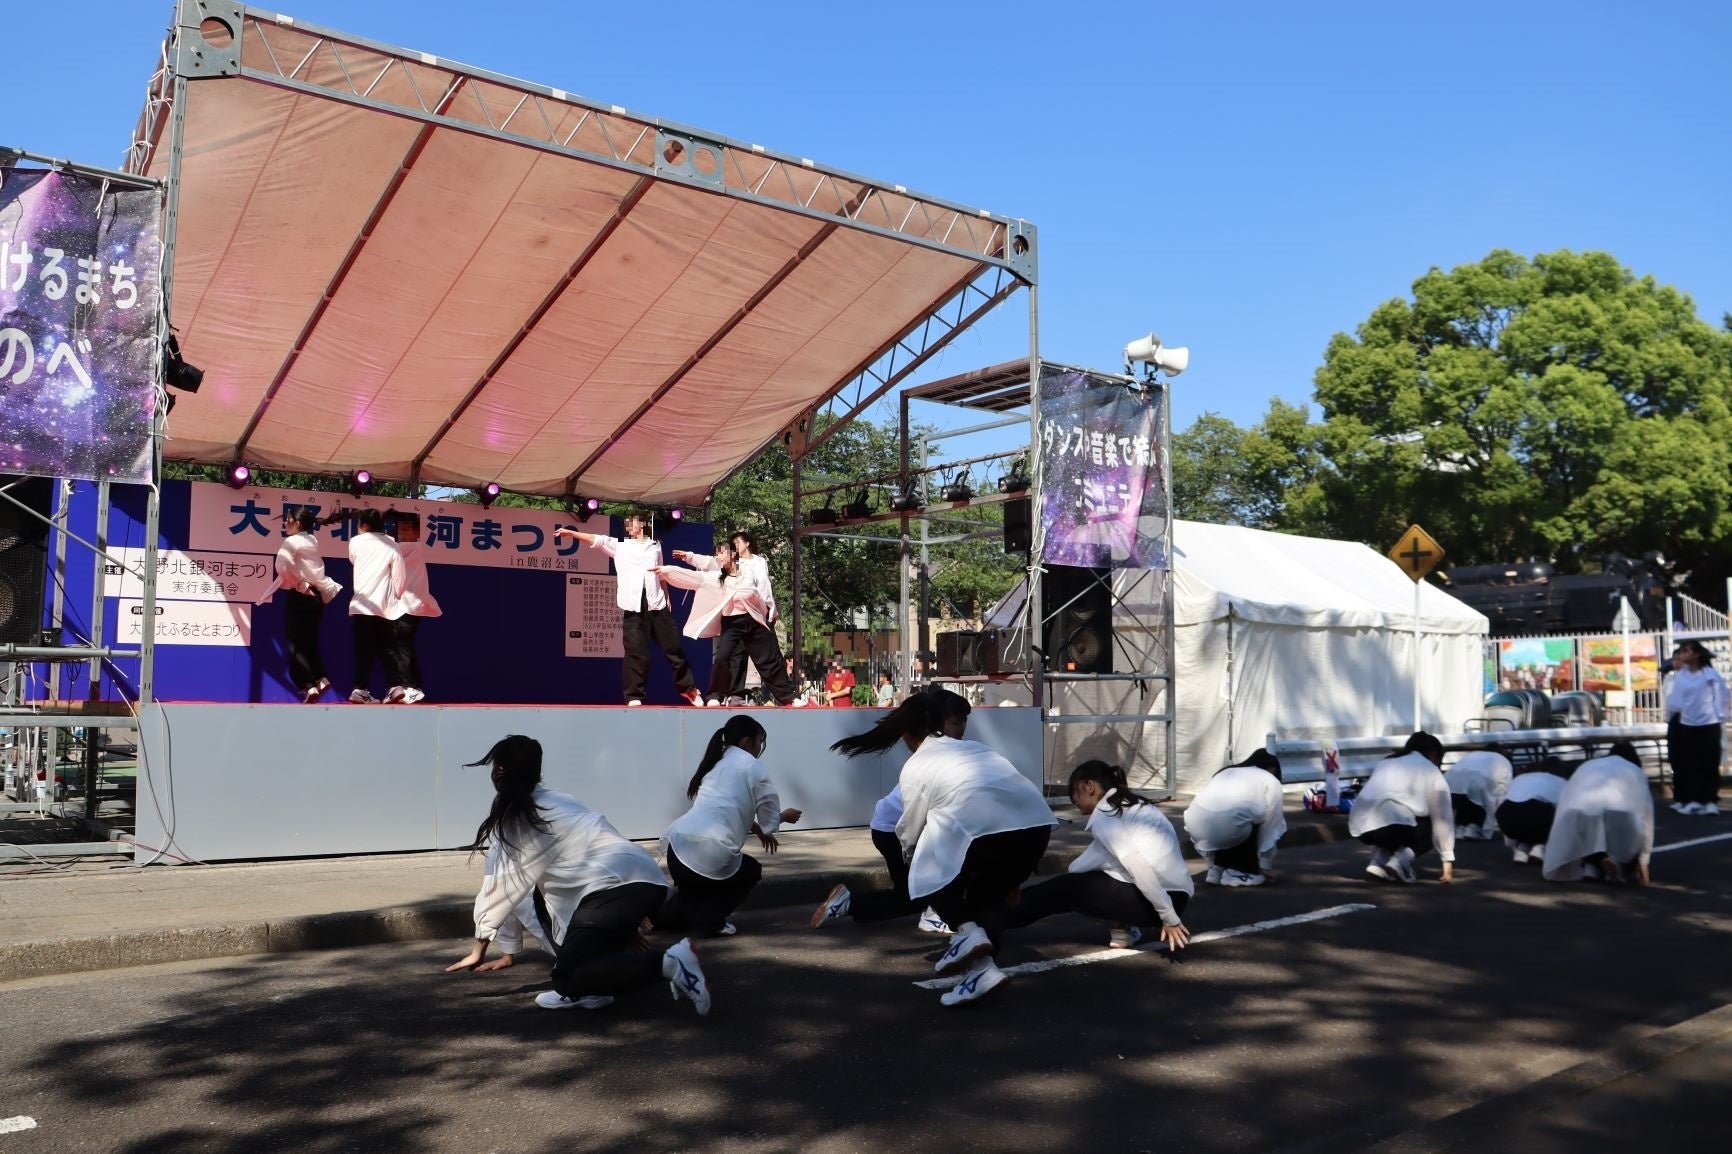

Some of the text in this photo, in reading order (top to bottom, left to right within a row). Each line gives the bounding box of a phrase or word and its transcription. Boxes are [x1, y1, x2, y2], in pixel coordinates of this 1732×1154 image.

[1, 240, 138, 309] けるまち
[0, 327, 93, 389] のべ
[172, 579, 240, 597] 実行委員会
[129, 619, 241, 638] 大北ふるさとまつり
